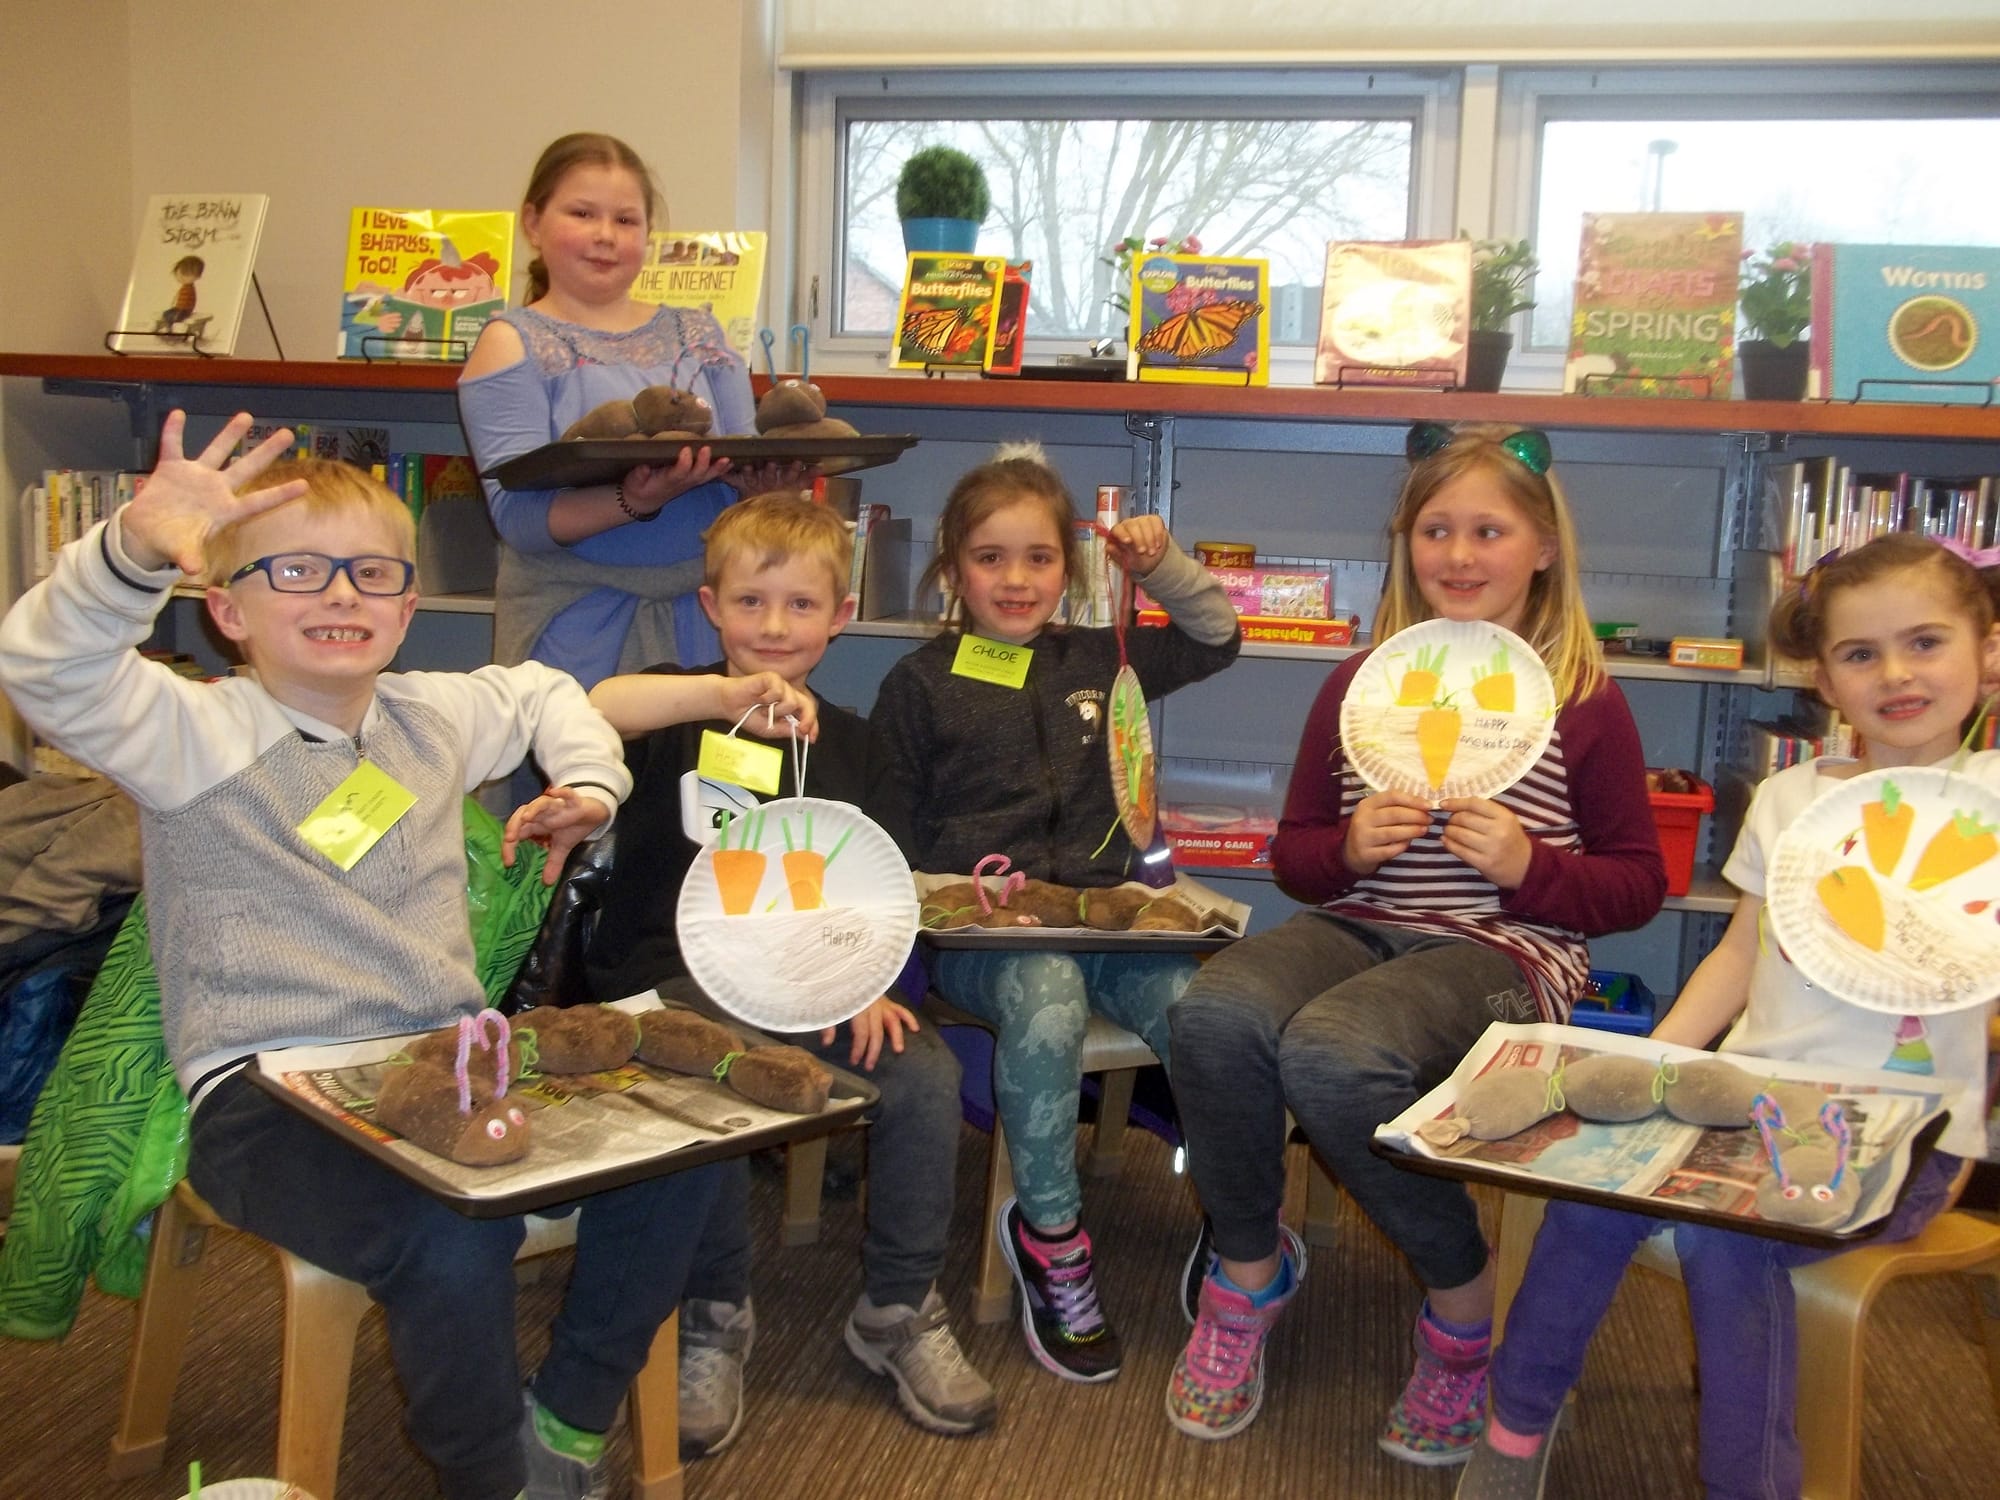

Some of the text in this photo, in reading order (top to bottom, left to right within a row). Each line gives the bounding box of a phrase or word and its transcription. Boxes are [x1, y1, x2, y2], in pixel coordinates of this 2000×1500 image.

[362, 210, 409, 229] I LOVE
[163, 227, 217, 248] STORM
[639, 270, 737, 291] THE INTERNET
[1184, 276, 1256, 292] Butterflies
[1881, 266, 1988, 290] Worms
[911, 282, 993, 300] Butterflies
[1585, 310, 1720, 342] SPRING
[1247, 626, 1315, 642] Alphabet
[972, 644, 1020, 663] CHLOE
[1177, 838, 1255, 849] DOMINO GAME
